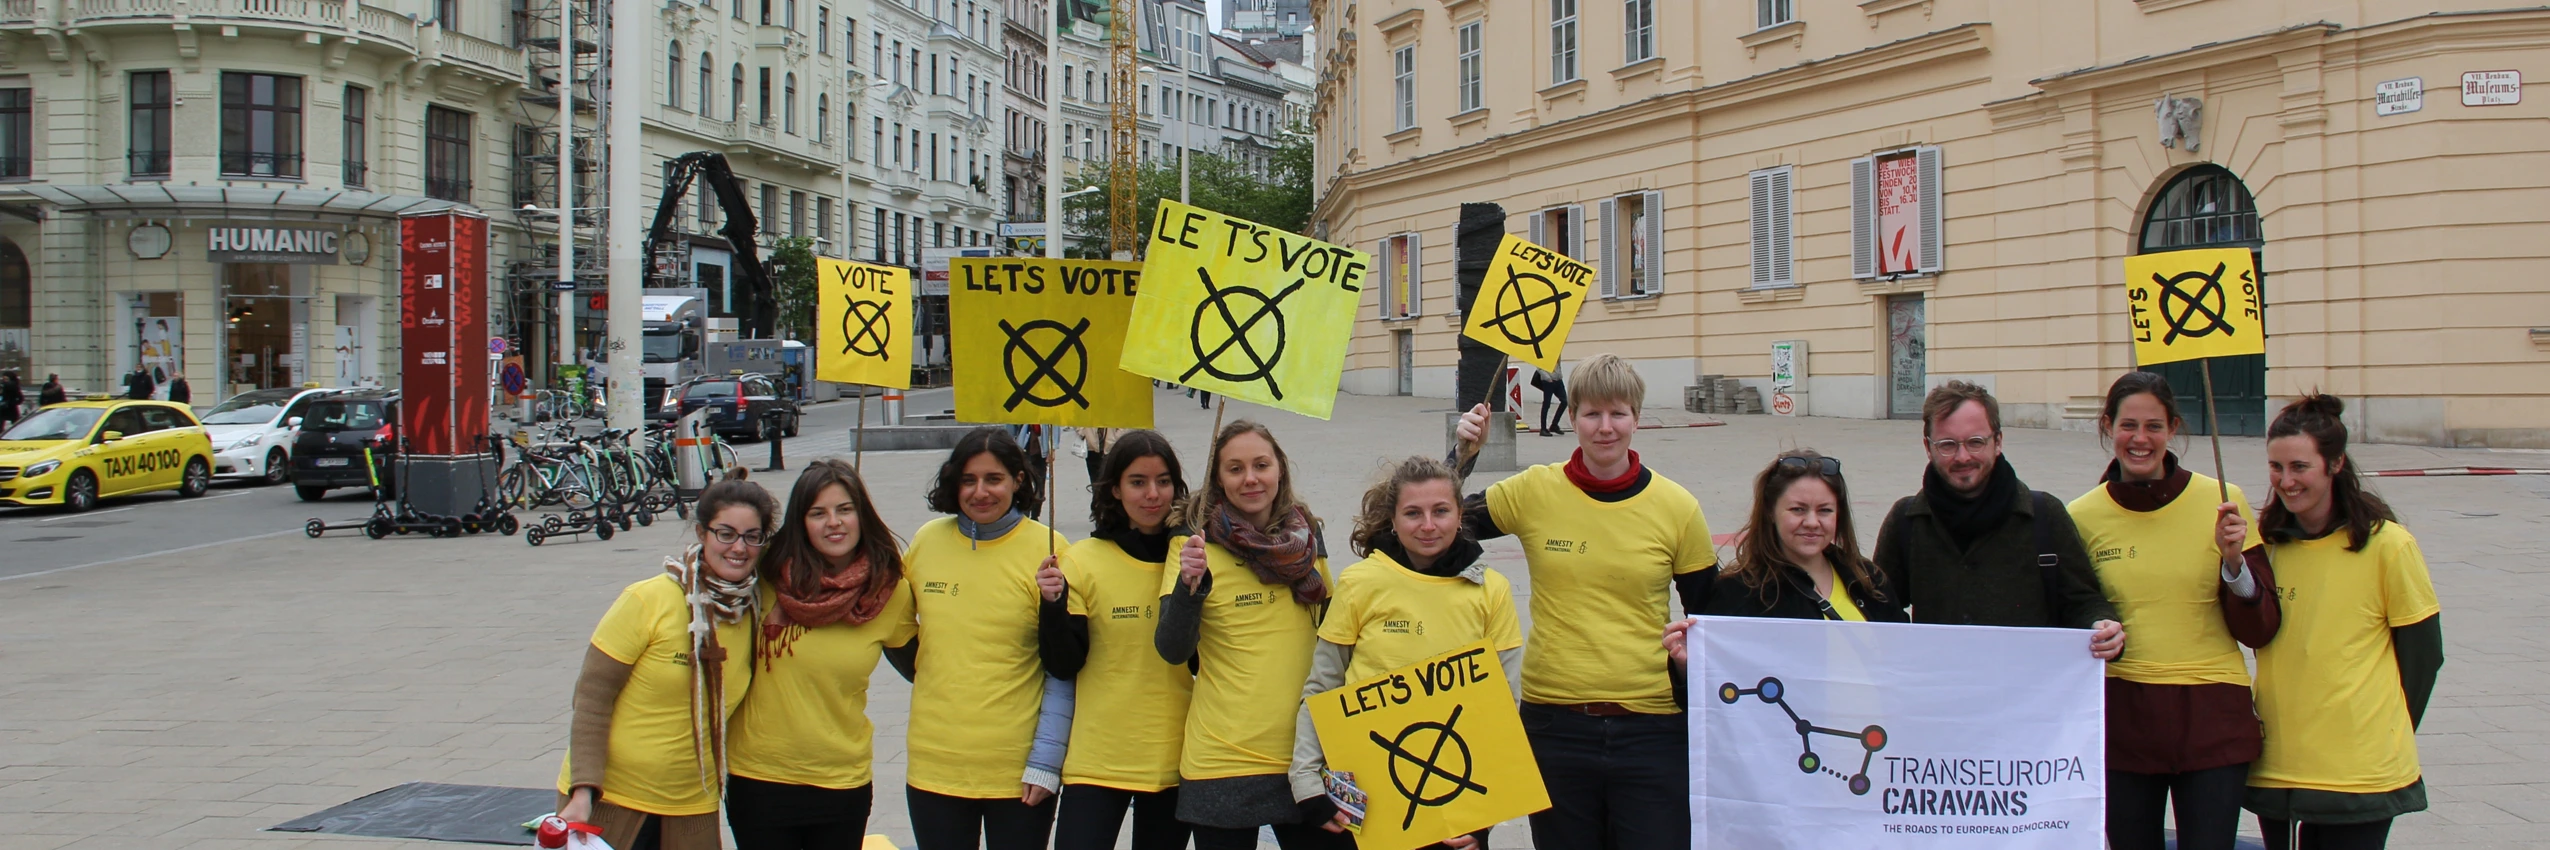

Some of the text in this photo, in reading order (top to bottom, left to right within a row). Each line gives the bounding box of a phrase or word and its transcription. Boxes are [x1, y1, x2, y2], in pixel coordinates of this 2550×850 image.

[1879, 166, 1917, 179] FESTWOCH
[1880, 157, 1917, 171] DIE WIEN
[1879, 175, 1917, 188] FINDEN 20
[1879, 188, 1892, 198] VON
[1880, 198, 1889, 207] BIS
[1909, 193, 1917, 203] JU
[1880, 205, 1900, 216] STATT.
[209, 227, 338, 254] HUMANIC
[402, 219, 415, 329] DANK AN
[461, 219, 472, 327] WOCHEN
[1279, 238, 1366, 292] VOTE
[1510, 242, 1593, 287] LET'S VOTE
[836, 265, 893, 295] VOTE
[962, 261, 1045, 295] LET'S
[1060, 266, 1141, 296] VOTE
[2240, 269, 2258, 320] VOTE
[2129, 287, 2151, 342] LET'S
[104, 455, 136, 479] TAXI
[1546, 539, 1573, 547] AMNESTY
[2096, 548, 2121, 558] AMNESTY
[925, 581, 948, 589] AMNESTY
[1235, 593, 1262, 601] AMNESTY
[1339, 648, 1489, 717] LET'S VOTE
[1884, 756, 2085, 786] TRANSEUROPA
[1883, 788, 2027, 816] CARAVANS
[1883, 820, 2070, 835] THE ROADS TO EUROPEAN DEMOCRACY
